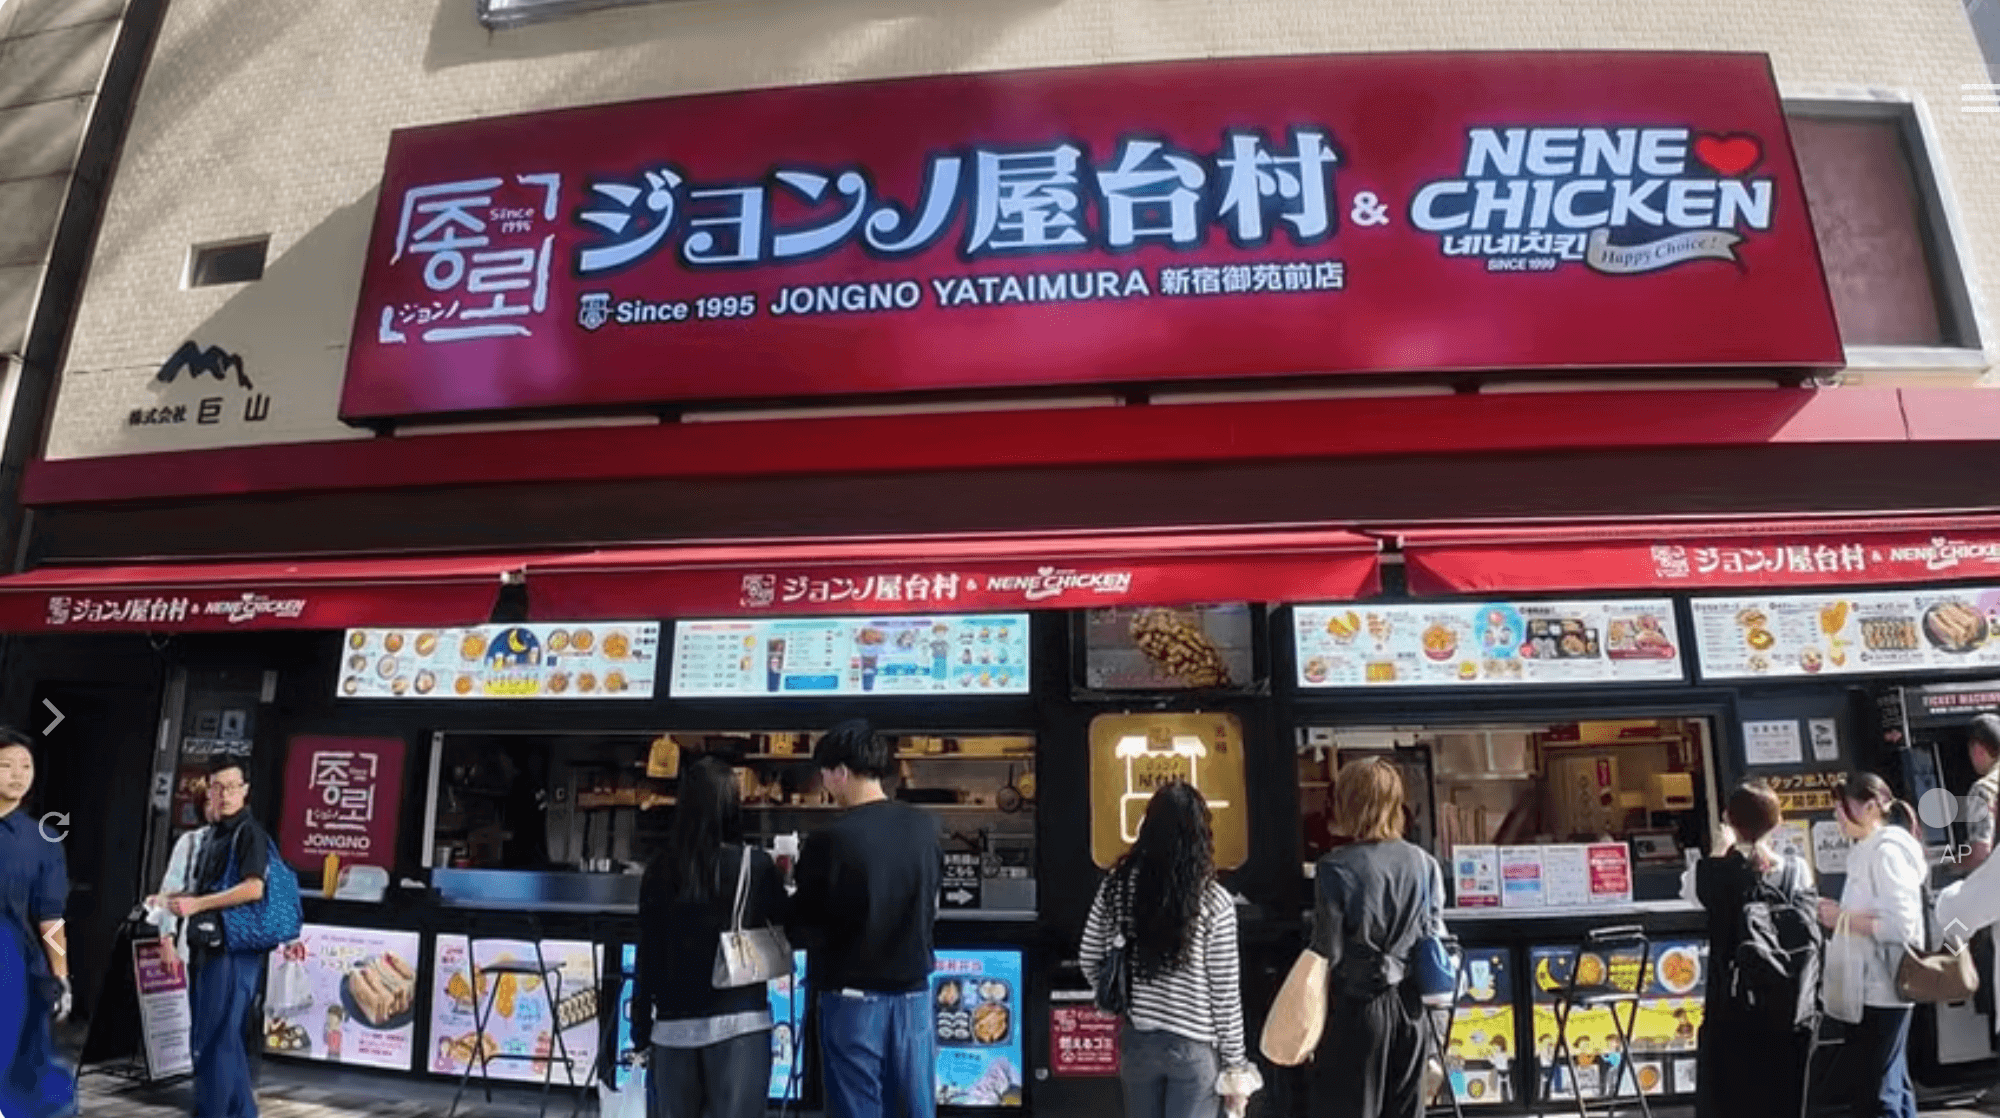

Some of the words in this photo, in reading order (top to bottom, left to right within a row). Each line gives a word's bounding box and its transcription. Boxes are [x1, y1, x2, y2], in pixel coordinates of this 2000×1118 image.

[1466, 127, 1690, 177] NENE
[489, 208, 535, 221] Since
[579, 131, 1338, 273] ジョンノ屋台村
[1350, 191, 1390, 227] &
[1410, 179, 1773, 231] CHICKEN
[1442, 230, 1588, 260] 네네치킨
[1601, 243, 1653, 267] Happy
[1488, 257, 1528, 271] SINCE
[615, 302, 690, 323] Since
[695, 296, 757, 319] 1995
[770, 281, 920, 315] JONGNO
[932, 269, 1151, 307] YATAIMURA
[1160, 261, 1344, 296] 新宿御苑前店
[129, 404, 187, 426] 株式会社
[1692, 543, 1866, 573] ジョンノ屋台村
[782, 573, 960, 603] ジョンノ屋台村
[303, 834, 371, 850] JONGNO
